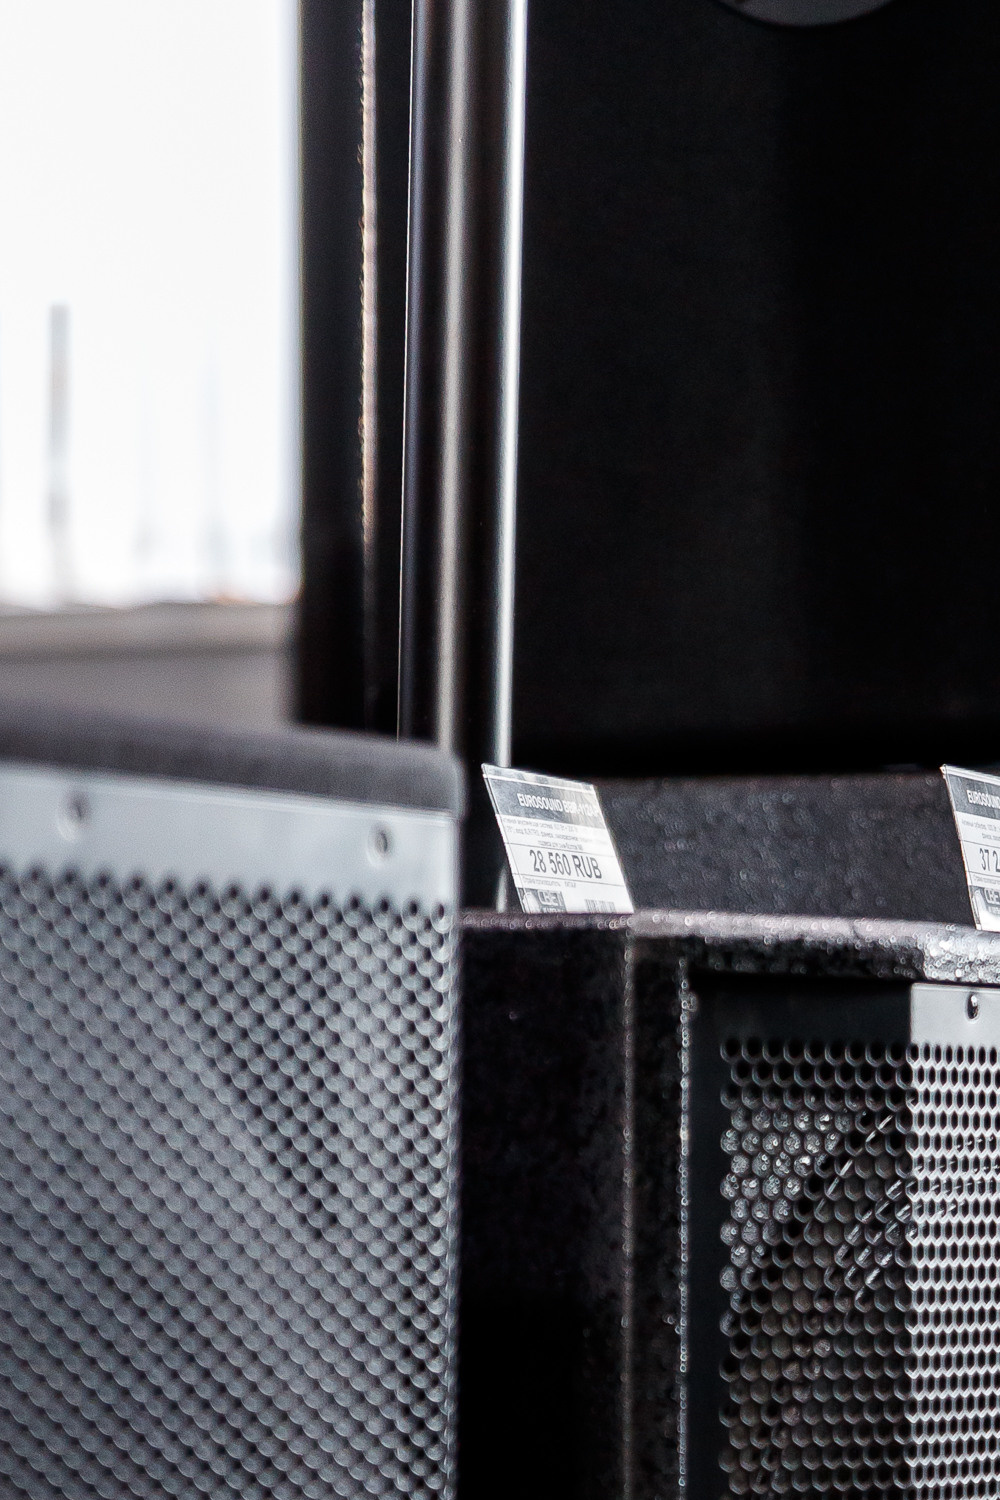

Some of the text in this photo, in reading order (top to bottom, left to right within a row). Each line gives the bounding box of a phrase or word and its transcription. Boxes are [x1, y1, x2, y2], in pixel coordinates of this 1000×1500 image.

[517, 792, 563, 812] EUROSOUND
[529, 849, 602, 879] 28 560 RUB
[979, 847, 991, 872] 37
